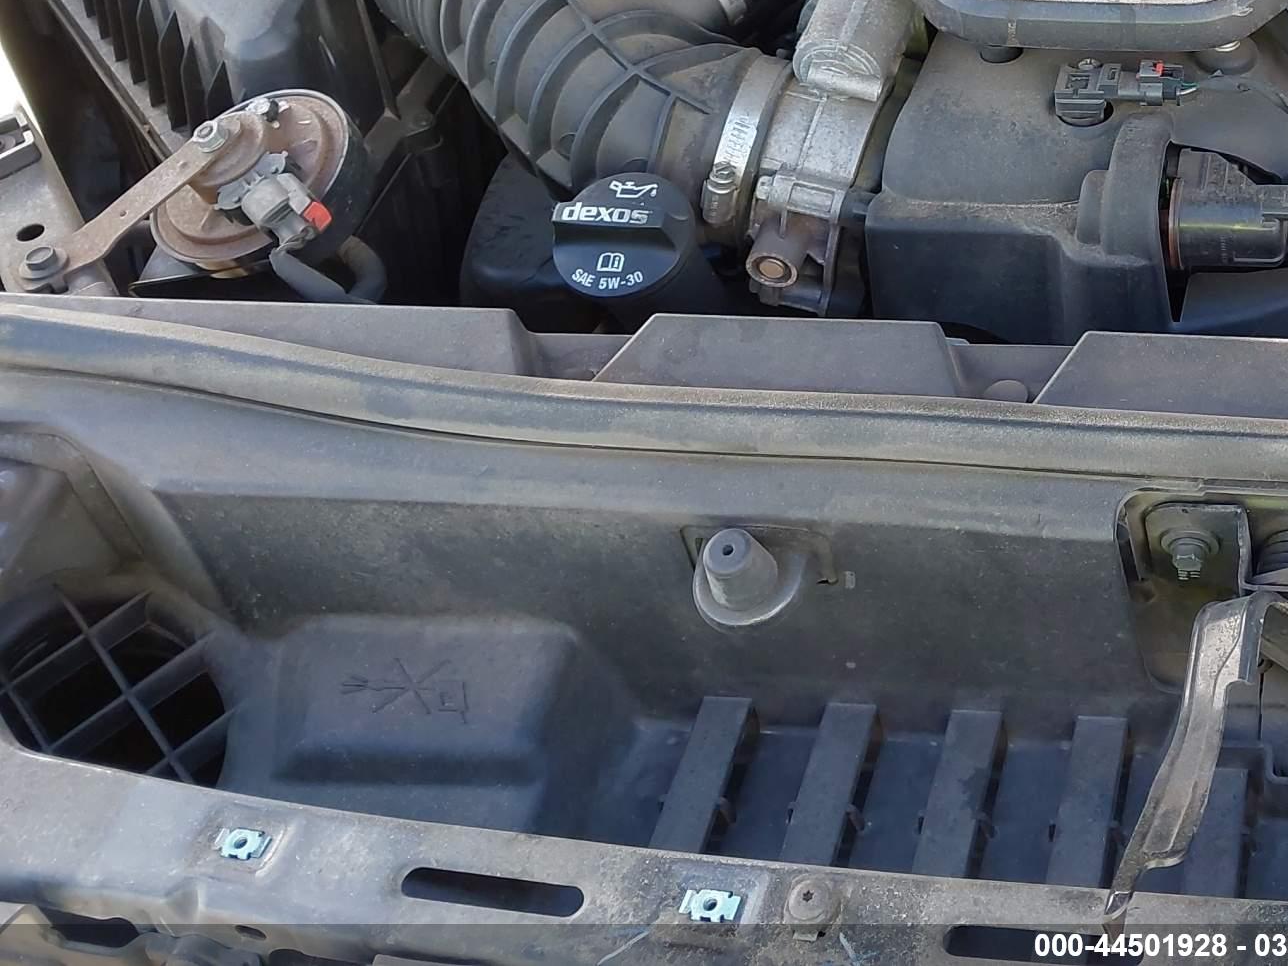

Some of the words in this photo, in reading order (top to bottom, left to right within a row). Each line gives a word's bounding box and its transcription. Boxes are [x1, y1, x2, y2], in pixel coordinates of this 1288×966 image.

[562, 202, 653, 224] dexos
[572, 269, 595, 287] SAE
[598, 271, 644, 290] 5W-30
